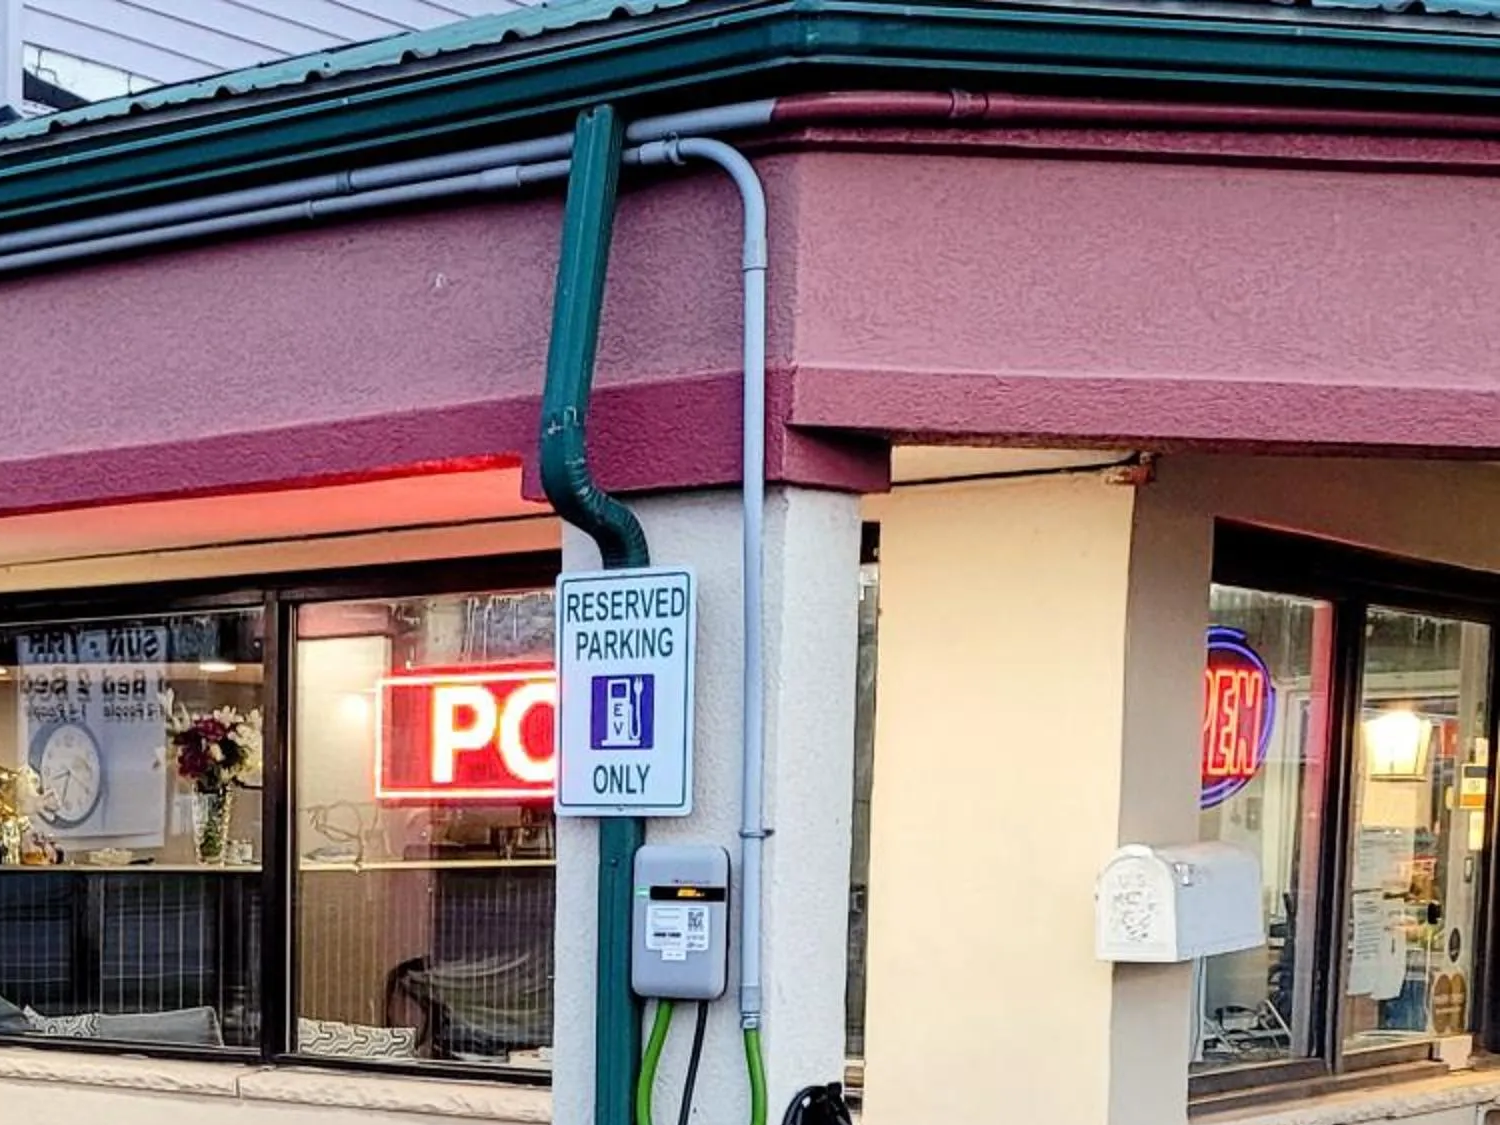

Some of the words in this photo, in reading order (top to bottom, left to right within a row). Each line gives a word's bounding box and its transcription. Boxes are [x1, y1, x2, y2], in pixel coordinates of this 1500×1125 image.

[567, 587, 685, 622] RESERVED
[576, 627, 673, 660] PARKING
[593, 764, 650, 794] ONLY
